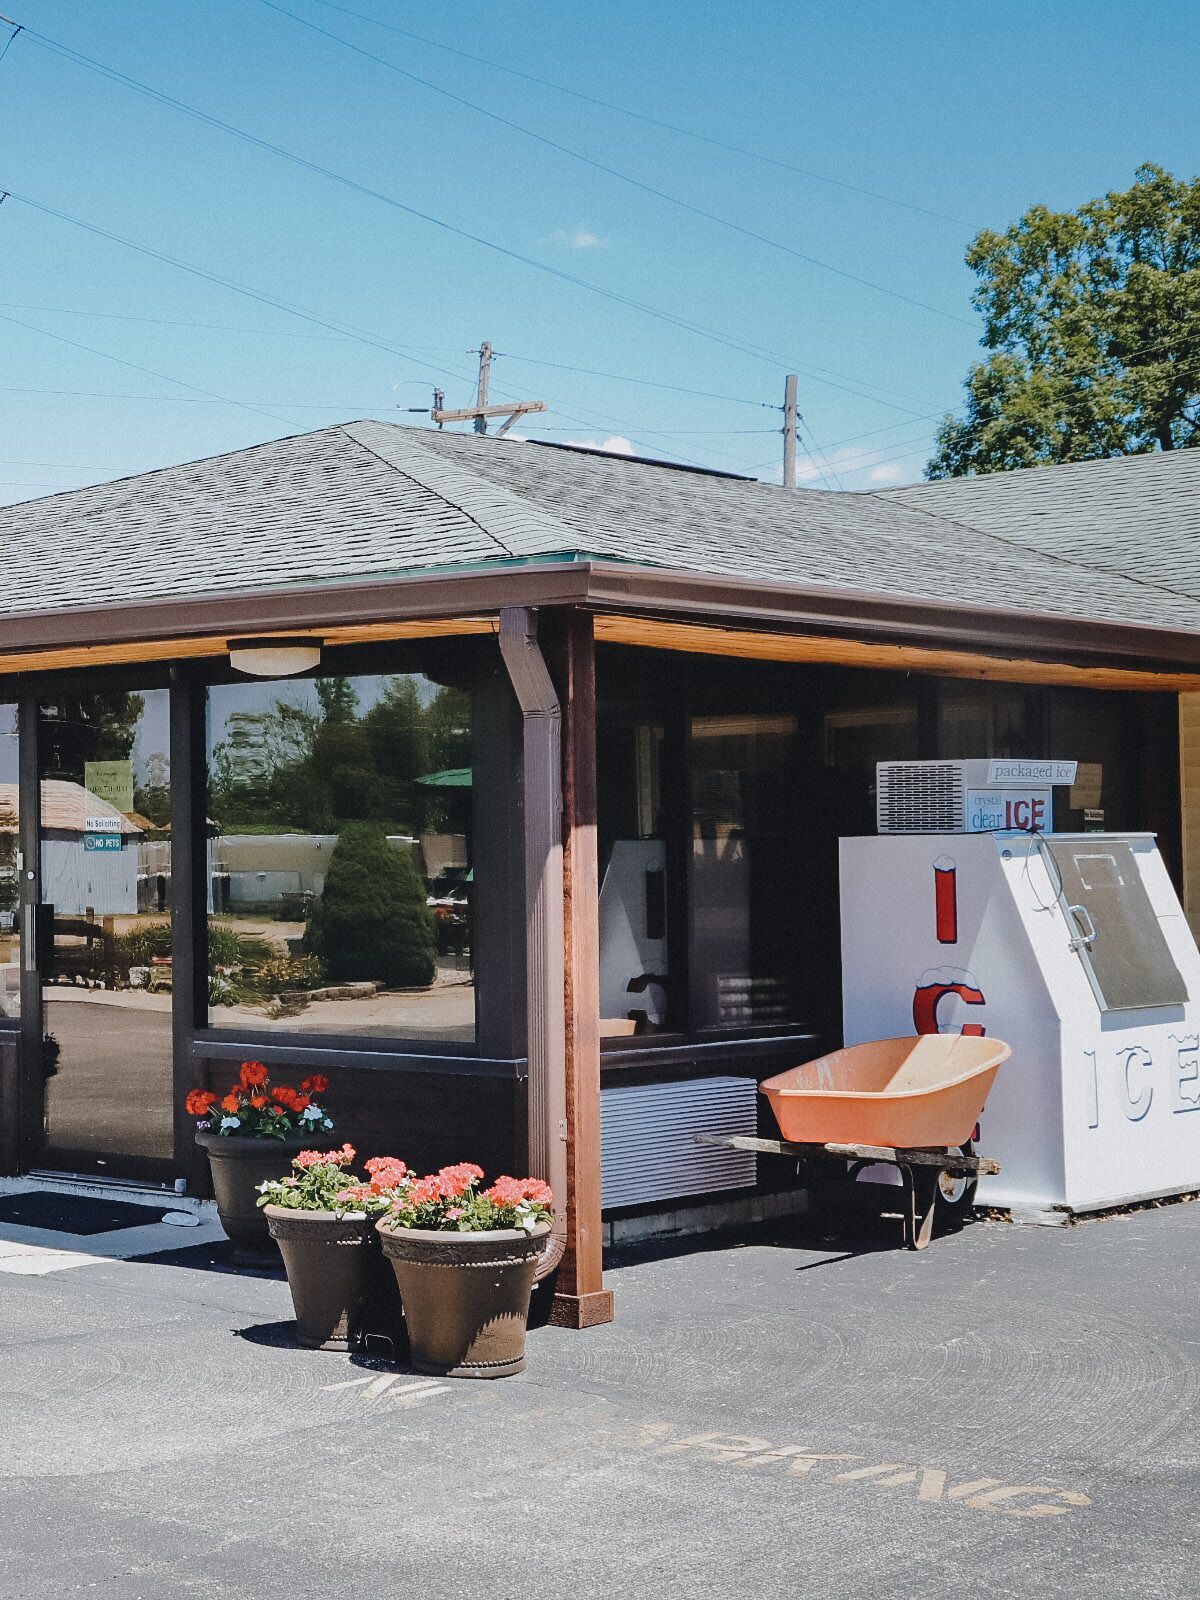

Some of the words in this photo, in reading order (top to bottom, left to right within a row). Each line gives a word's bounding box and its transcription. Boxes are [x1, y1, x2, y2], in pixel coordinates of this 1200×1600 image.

[995, 763, 1053, 780] packaged
[1055, 765, 1072, 778] ice
[974, 796, 1002, 809] crystal
[972, 808, 1003, 829] clear
[1005, 798, 1046, 831] ICE
[86, 820, 94, 828] No
[95, 819, 120, 829] Soliciting
[95, 839, 104, 847] NO
[105, 838, 120, 848] PETS
